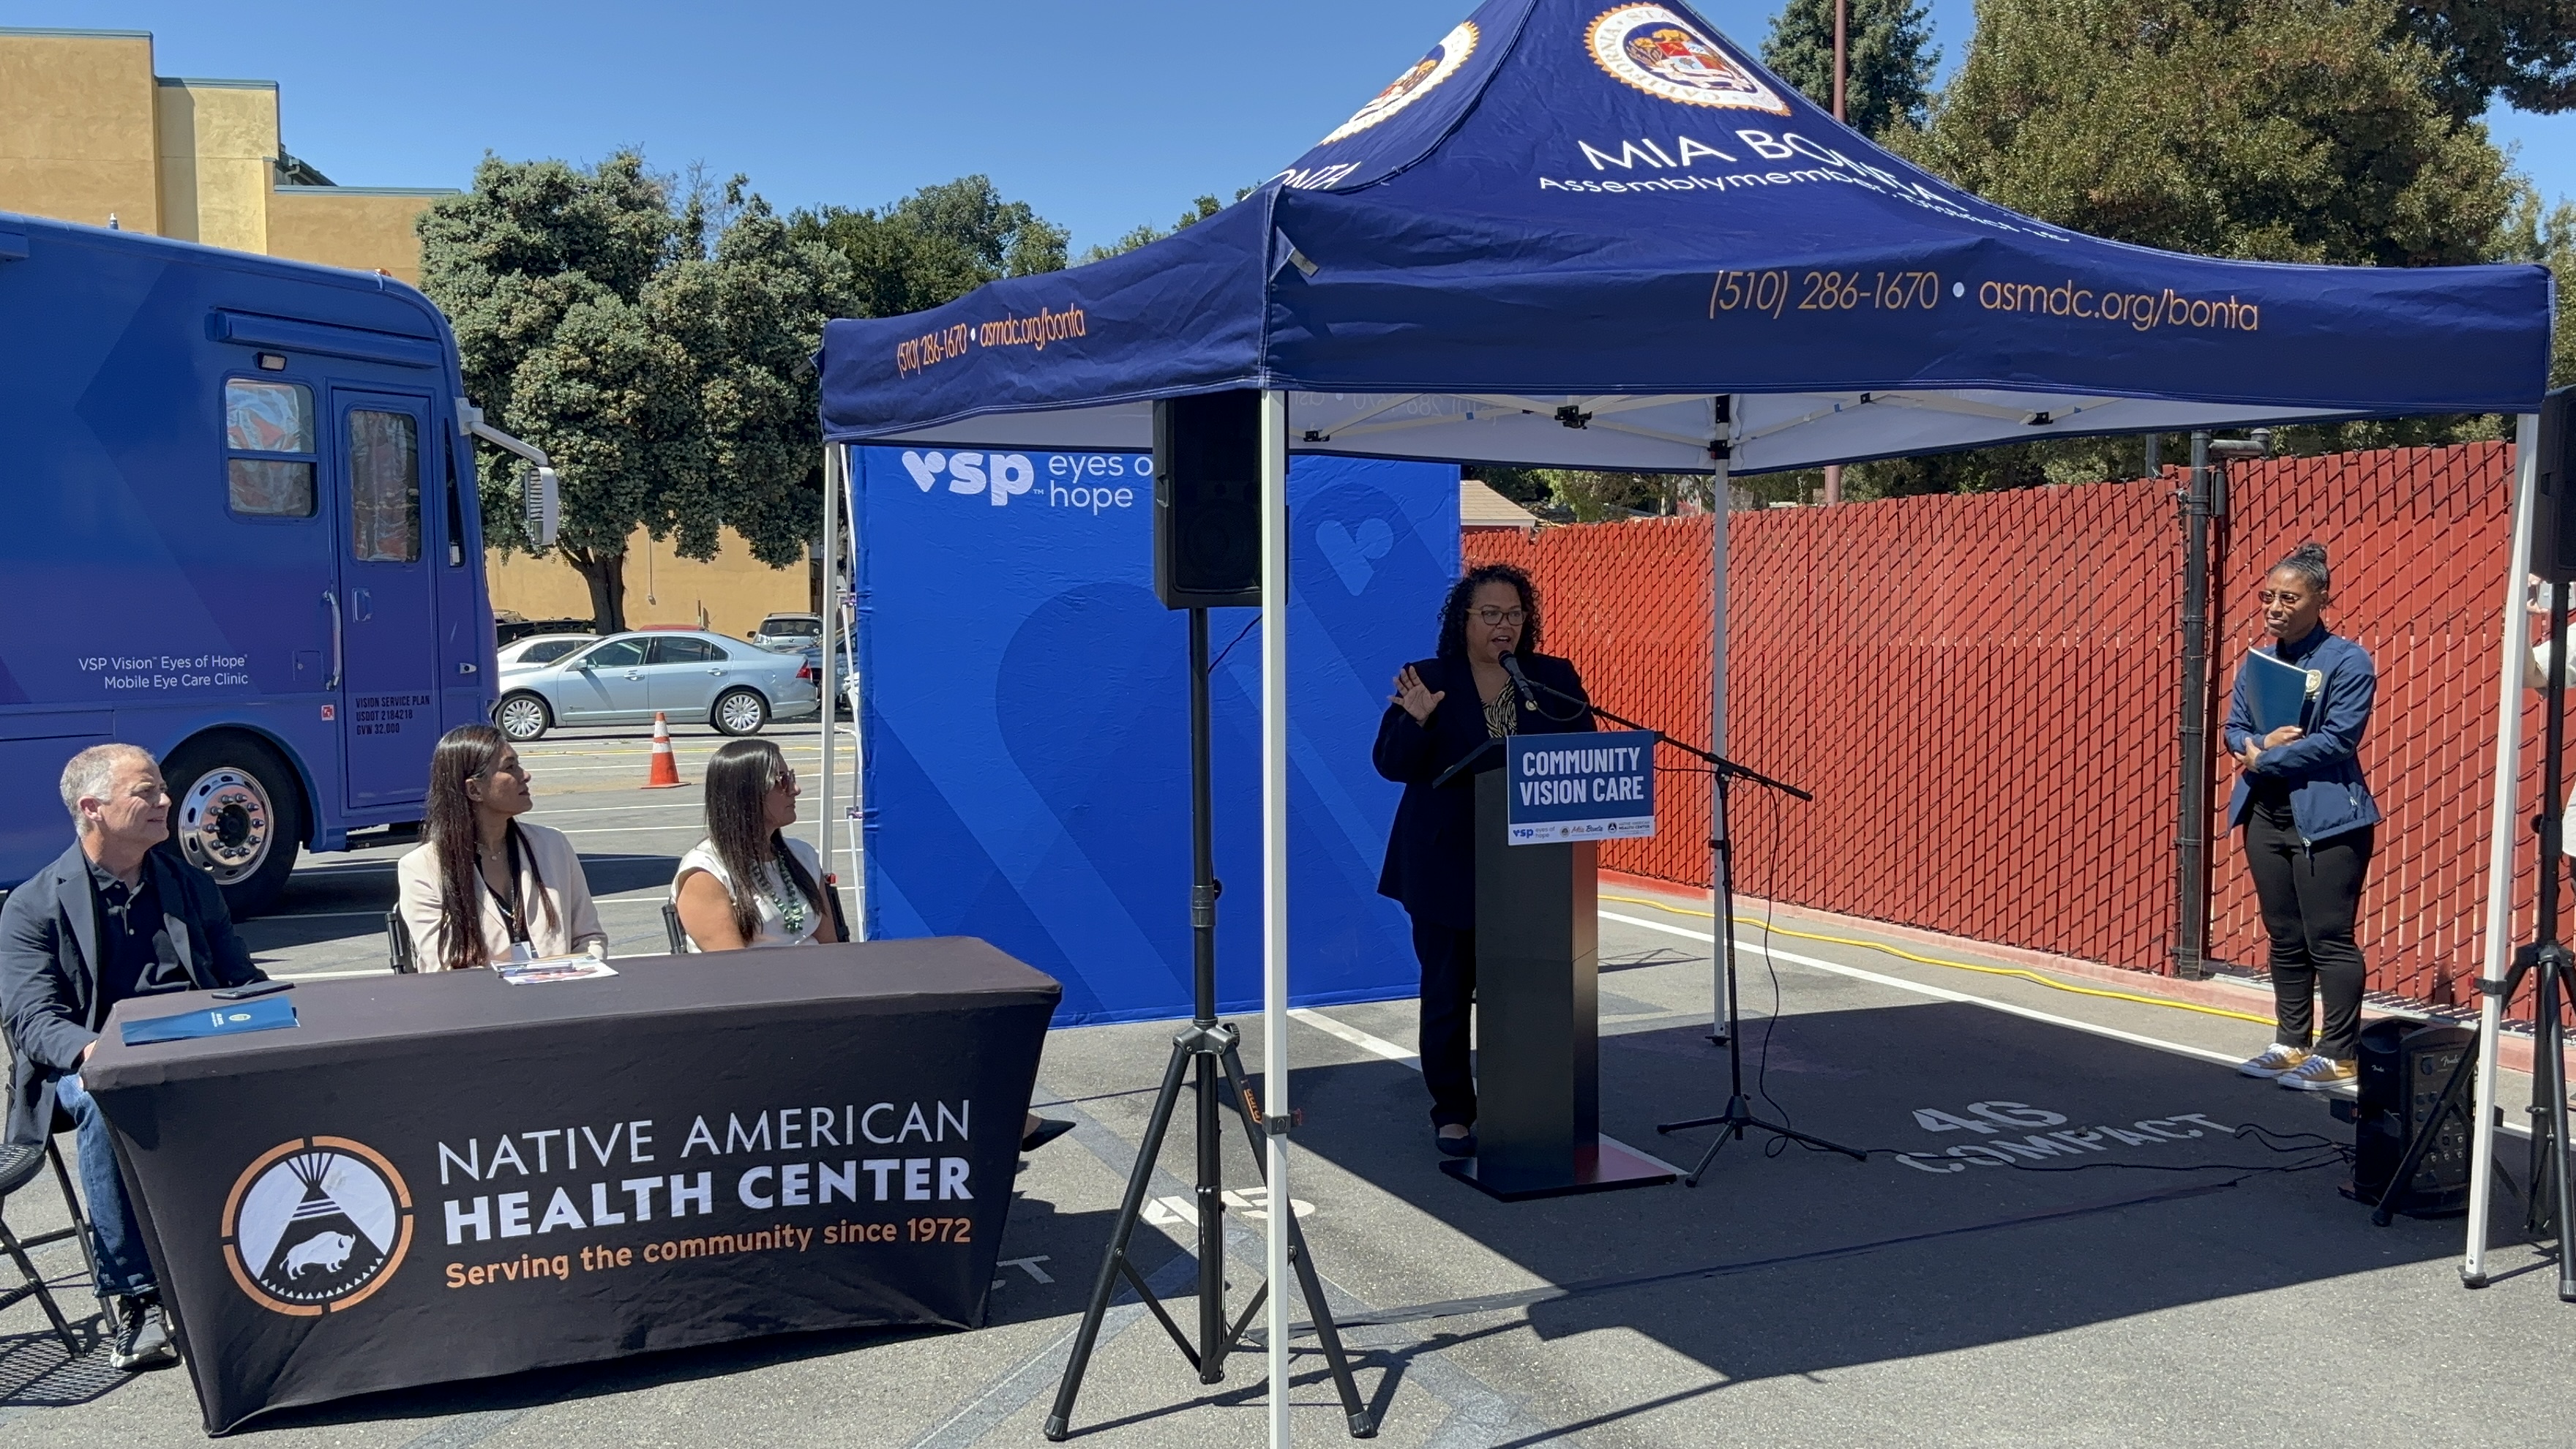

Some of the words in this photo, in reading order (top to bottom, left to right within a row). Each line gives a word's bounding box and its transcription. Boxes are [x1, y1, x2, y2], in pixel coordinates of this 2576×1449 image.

[1539, 165, 1887, 195] Assemblymember
[1577, 135, 1737, 171] MIA
[1735, 129, 1970, 213] BONTA
[1709, 270, 1789, 320] (510)
[1798, 272, 1939, 310] 286-1670
[1979, 280, 2259, 332] asmdc.org/bonta
[896, 336, 921, 380] (510)
[920, 323, 967, 366] 286-1670
[980, 302, 1087, 351] asmdc.org/bonta
[1048, 455, 1124, 484] eyes
[1134, 455, 1153, 476] o
[1049, 480, 1134, 516] hope
[78, 658, 108, 671] VSP
[161, 656, 192, 671] Eyes
[195, 655, 209, 668] of
[104, 674, 150, 690] Mobile
[154, 675, 178, 690] Eye
[181, 673, 211, 686] Care
[214, 672, 249, 686] Clinic
[356, 697, 380, 708] VISION
[381, 695, 411, 707] SERVICE
[412, 694, 430, 706] PLAN
[356, 711, 379, 722] USDOT
[1522, 746, 1641, 777] COMMUNITY
[1519, 779, 1587, 806] VISION
[1592, 776, 1645, 803] CARE
[1513, 828, 1534, 839] vsp
[438, 1119, 655, 1185] NATIVE
[680, 1099, 970, 1158] AMERICAN
[1895, 1112, 2237, 1173] COMPACT
[443, 1171, 712, 1246] HEALTH
[738, 1156, 975, 1210] CENTER
[445, 1252, 569, 1289] Serving
[580, 1243, 633, 1271] the
[643, 1223, 813, 1264] community
[823, 1219, 897, 1245] since
[907, 1218, 972, 1243] 1972
